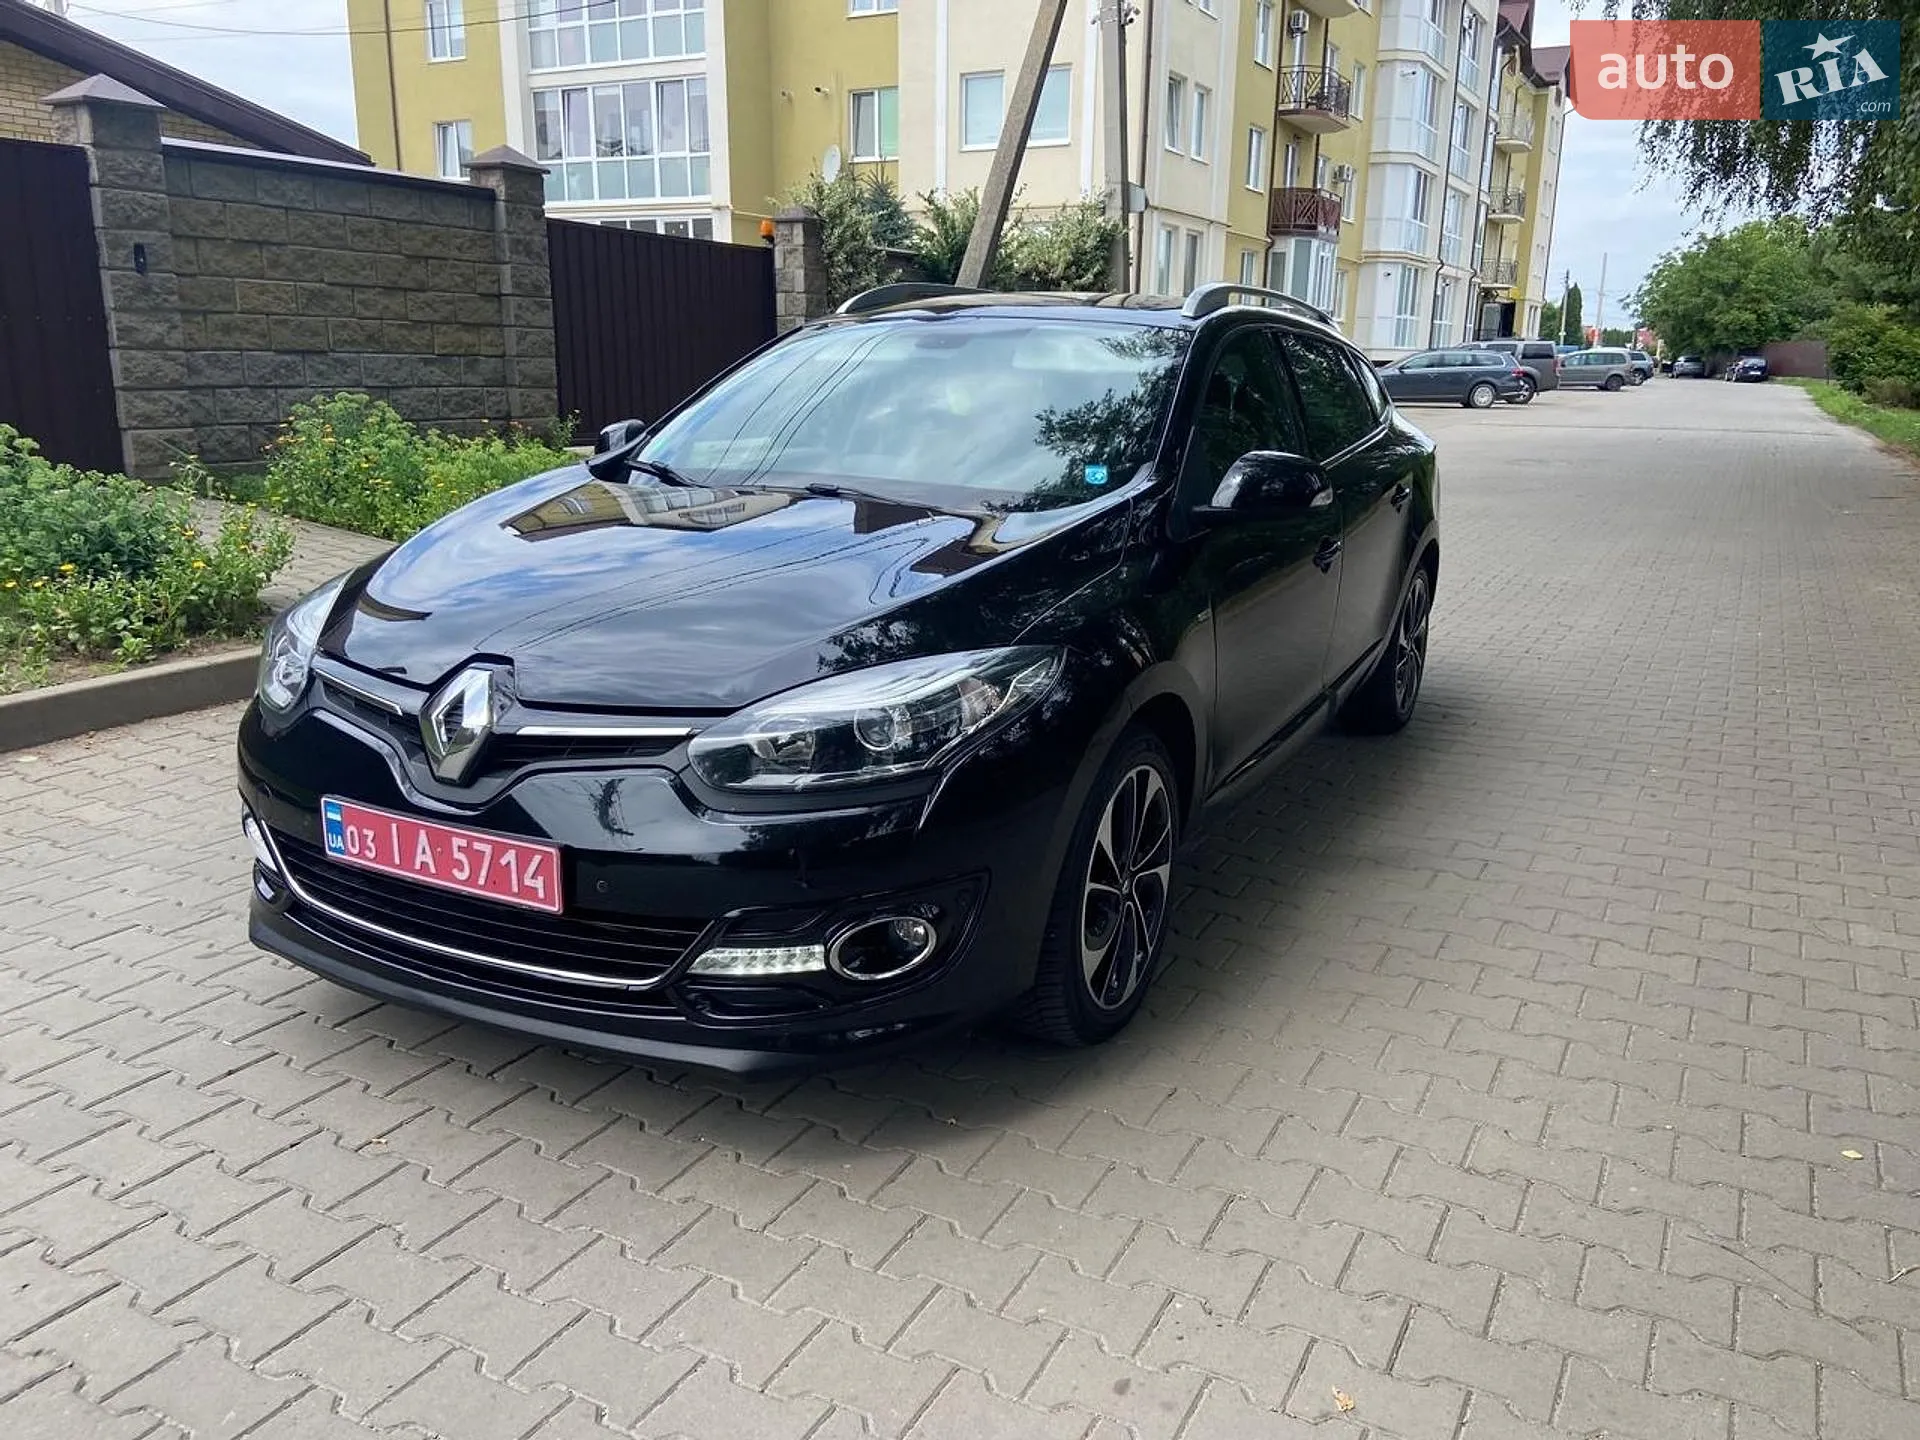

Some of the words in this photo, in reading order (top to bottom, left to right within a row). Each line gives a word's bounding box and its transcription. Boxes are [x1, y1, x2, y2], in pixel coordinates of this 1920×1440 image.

[328, 833, 345, 851] UA
[346, 825, 377, 860] 03
[451, 836, 545, 899] 5714
